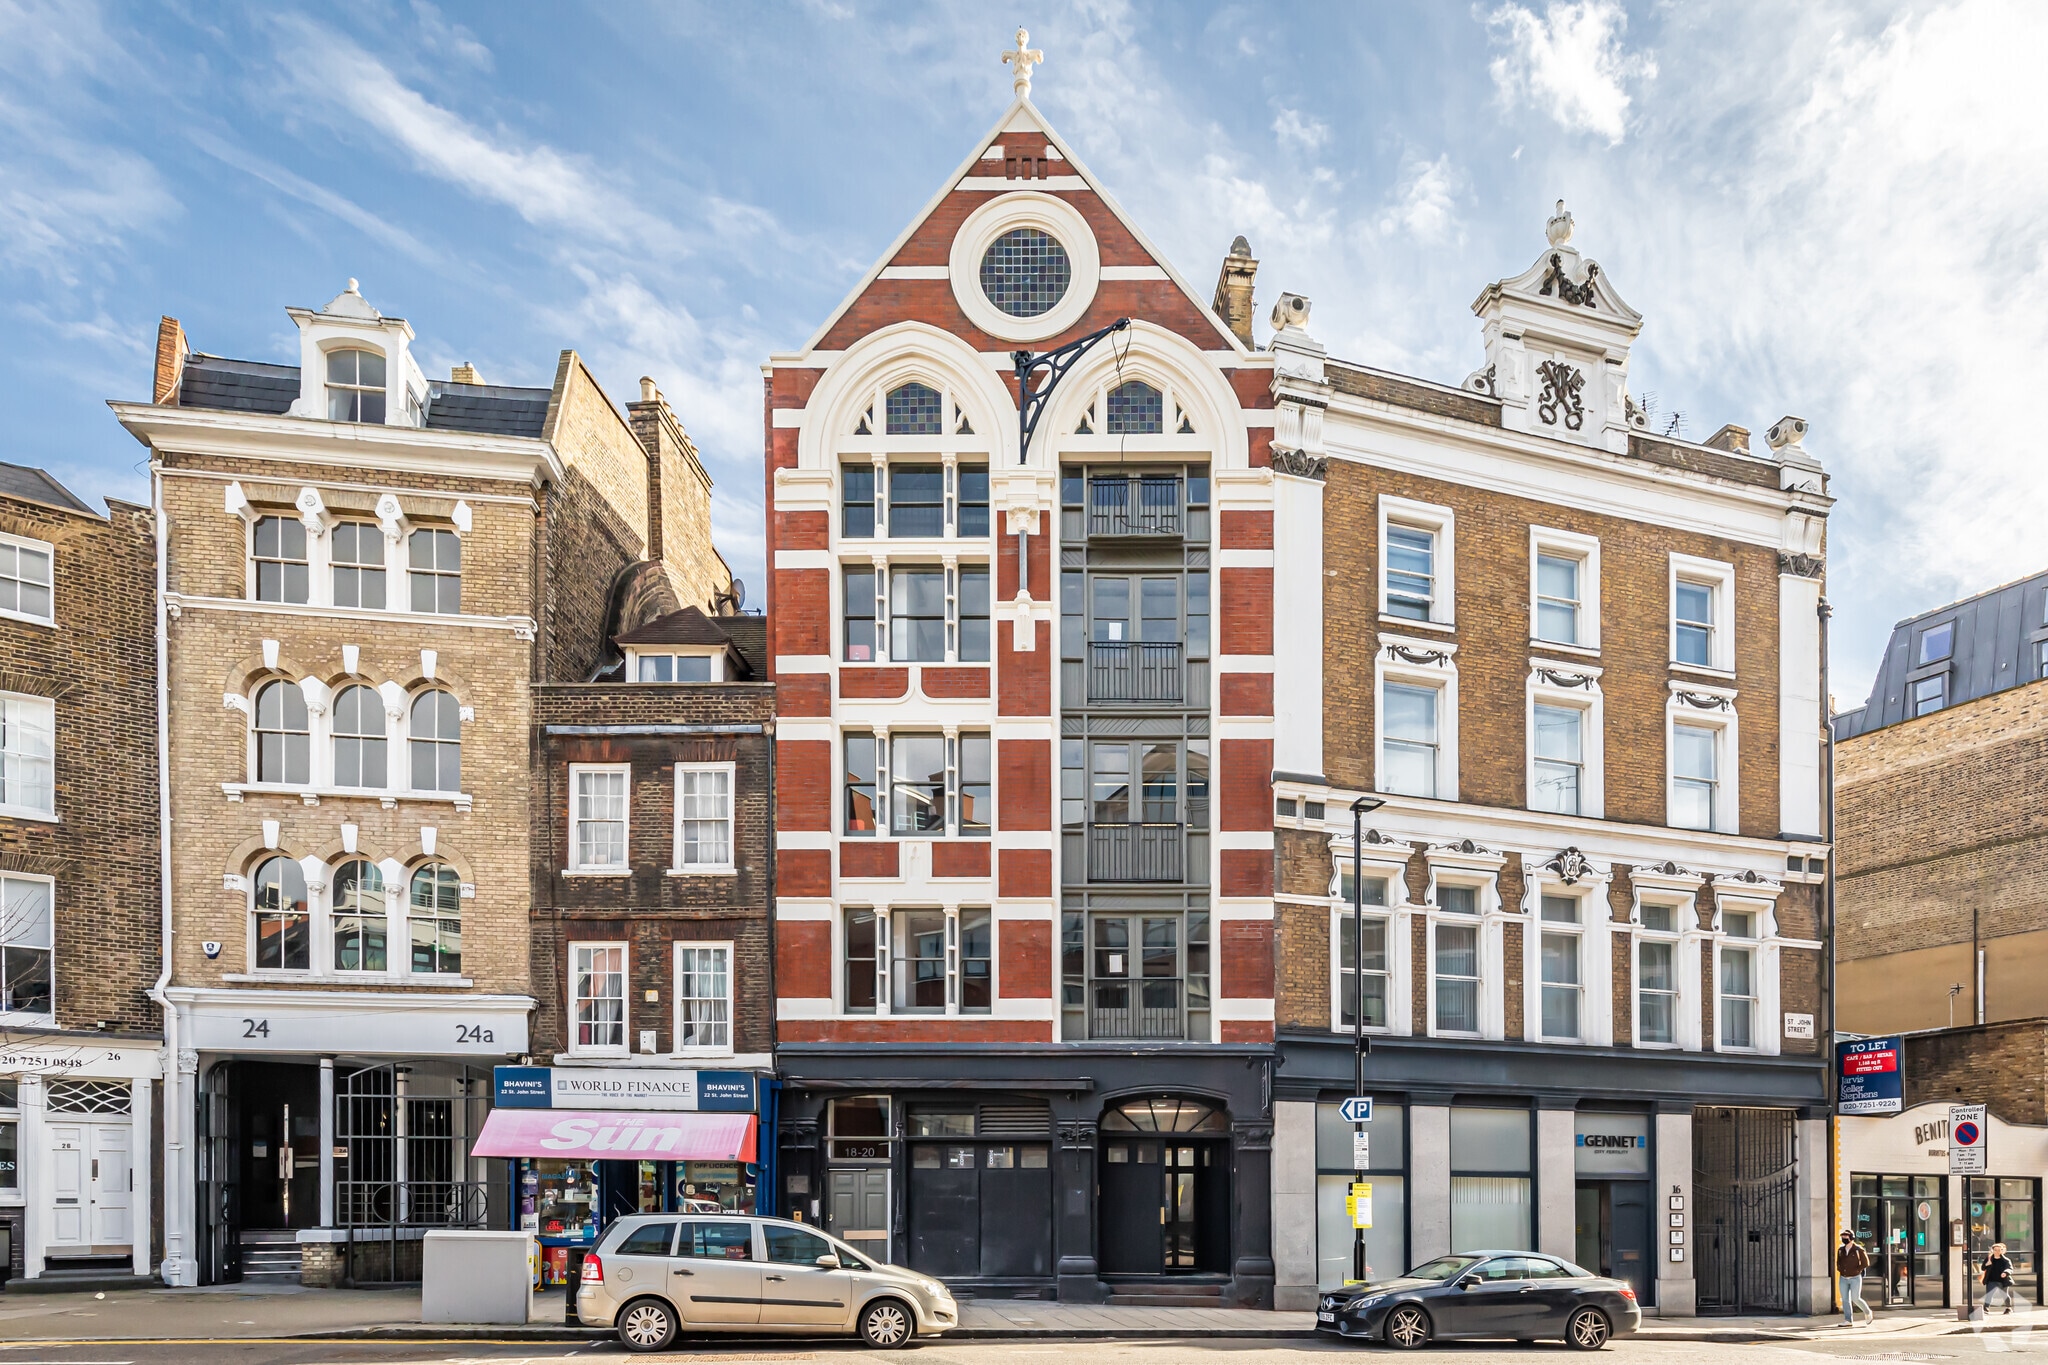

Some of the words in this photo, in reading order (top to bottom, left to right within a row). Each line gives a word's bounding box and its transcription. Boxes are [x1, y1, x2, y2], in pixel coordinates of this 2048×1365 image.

[242, 1018, 270, 1038] 24
[455, 1024, 495, 1043] 24a
[1787, 1026, 1807, 1034] STREET
[1849, 1043, 1866, 1053] TO
[1868, 1041, 1888, 1051] LET
[20, 1056, 48, 1067] 7251
[53, 1058, 82, 1068] 0848
[107, 1052, 121, 1061] 26
[503, 1080, 543, 1088] BHAVINI'S
[1841, 1075, 1865, 1086] Jarvis
[570, 1080, 622, 1092] WORLD
[627, 1081, 691, 1093] FINANCE
[1841, 1084, 1864, 1094] Keller
[1840, 1090, 1879, 1101] Stephens
[1950, 1106, 1984, 1114] Controlled
[615, 1118, 647, 1126] THE
[1955, 1113, 1979, 1121] ZONE
[540, 1118, 682, 1151] Sun
[1915, 1119, 1950, 1146] BENIT
[1584, 1135, 1637, 1148] GENNET
[844, 1147, 875, 1158] 18-20
[1672, 1184, 1682, 1194] 16
